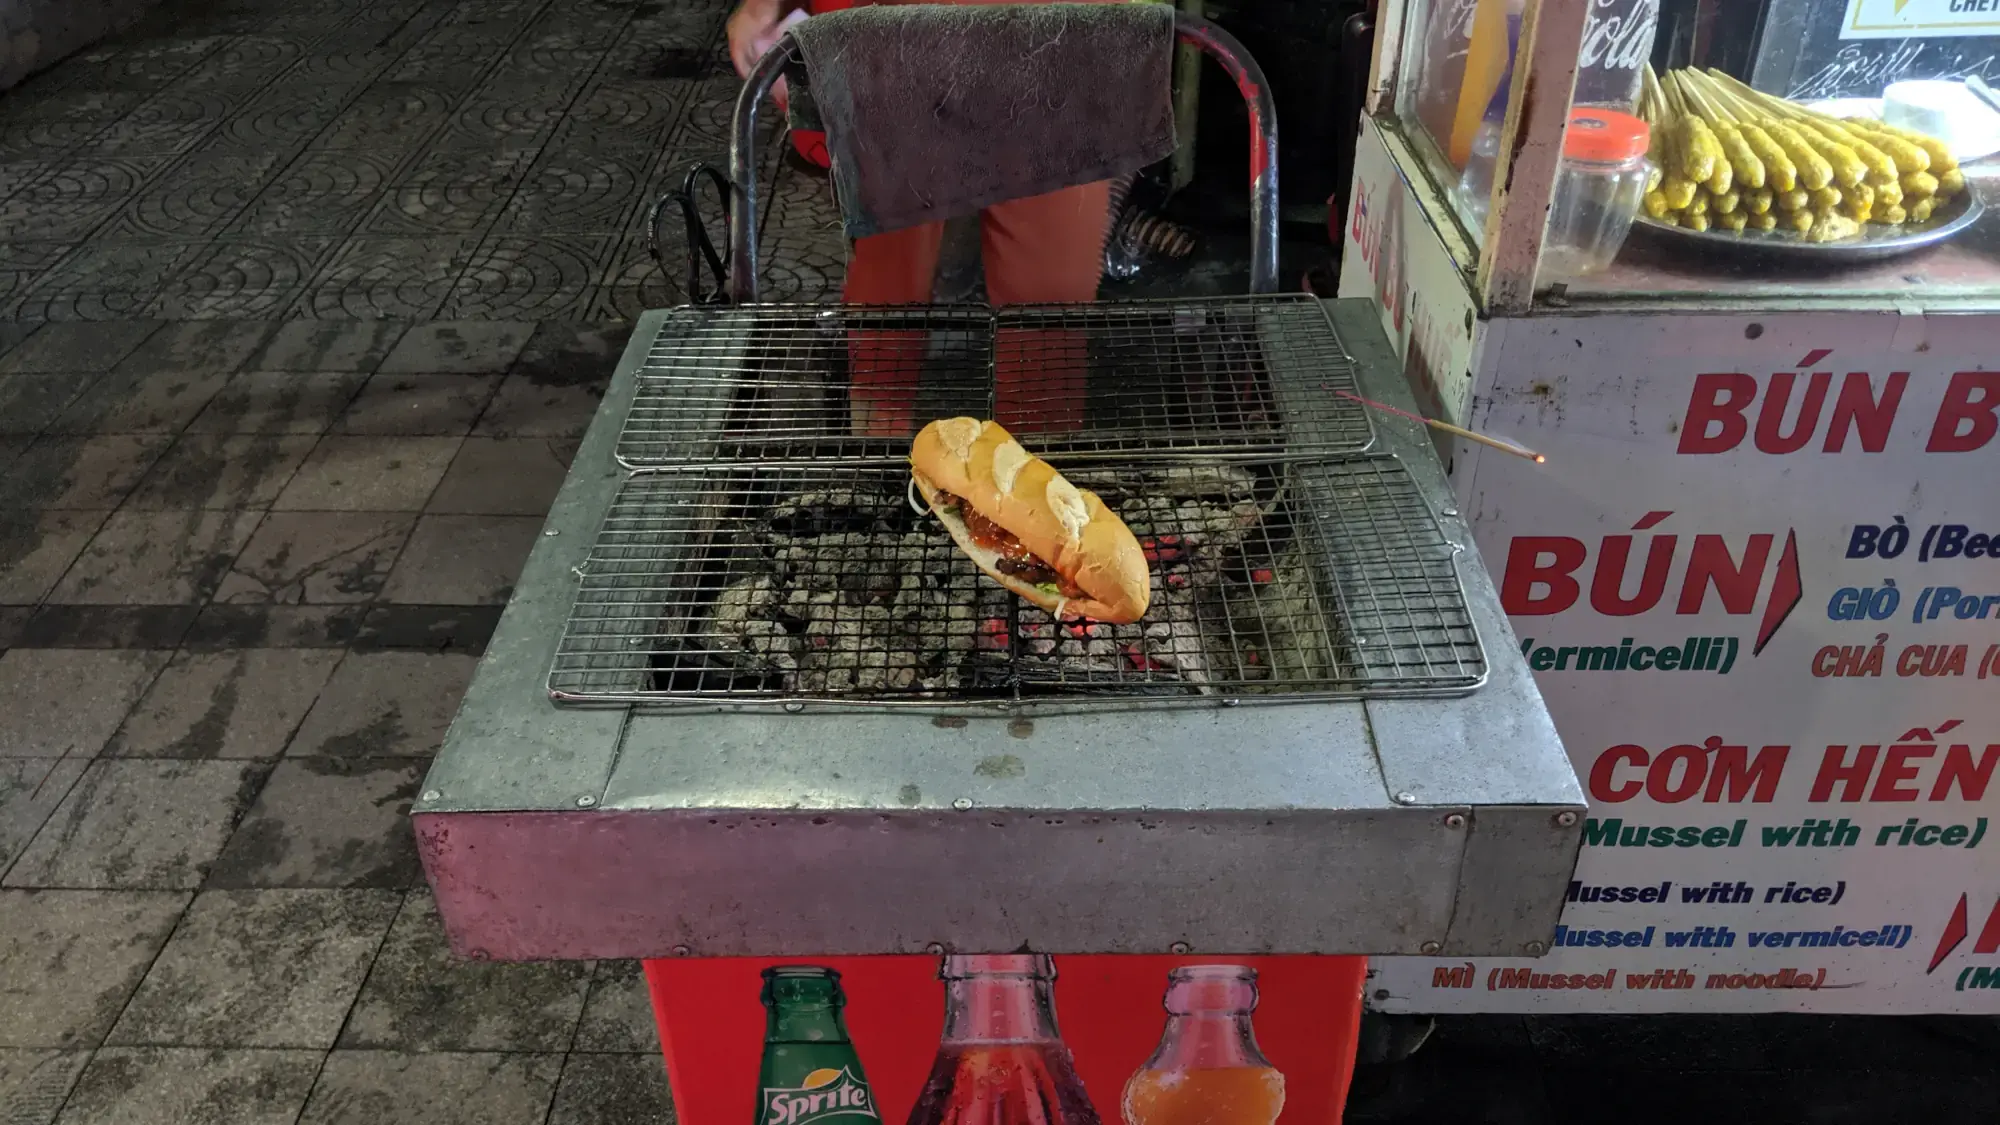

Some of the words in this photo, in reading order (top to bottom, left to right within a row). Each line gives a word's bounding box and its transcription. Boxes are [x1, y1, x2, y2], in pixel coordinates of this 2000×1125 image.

[1676, 349, 1912, 455] BÚN
[1845, 515, 1910, 559] BÒ
[1501, 511, 1775, 617] BÚN
[1827, 578, 1900, 621] GIÒ
[1912, 587, 2000, 624] (Por
[1811, 633, 1889, 678] CHẢ
[1896, 644, 1968, 677] CUA
[1588, 735, 1791, 804] CƠM
[1808, 719, 2000, 803] HẾN
[1762, 819, 1861, 847] with
[1875, 817, 1988, 849] rice)
[1681, 881, 1754, 903] with
[1764, 881, 1846, 905] rice)
[1664, 926, 1736, 948] with
[1487, 967, 1617, 991] (Mussel
[1626, 968, 1696, 989] with
[1705, 967, 1827, 991] noodle)
[768, 1078, 867, 1125] Sprite
